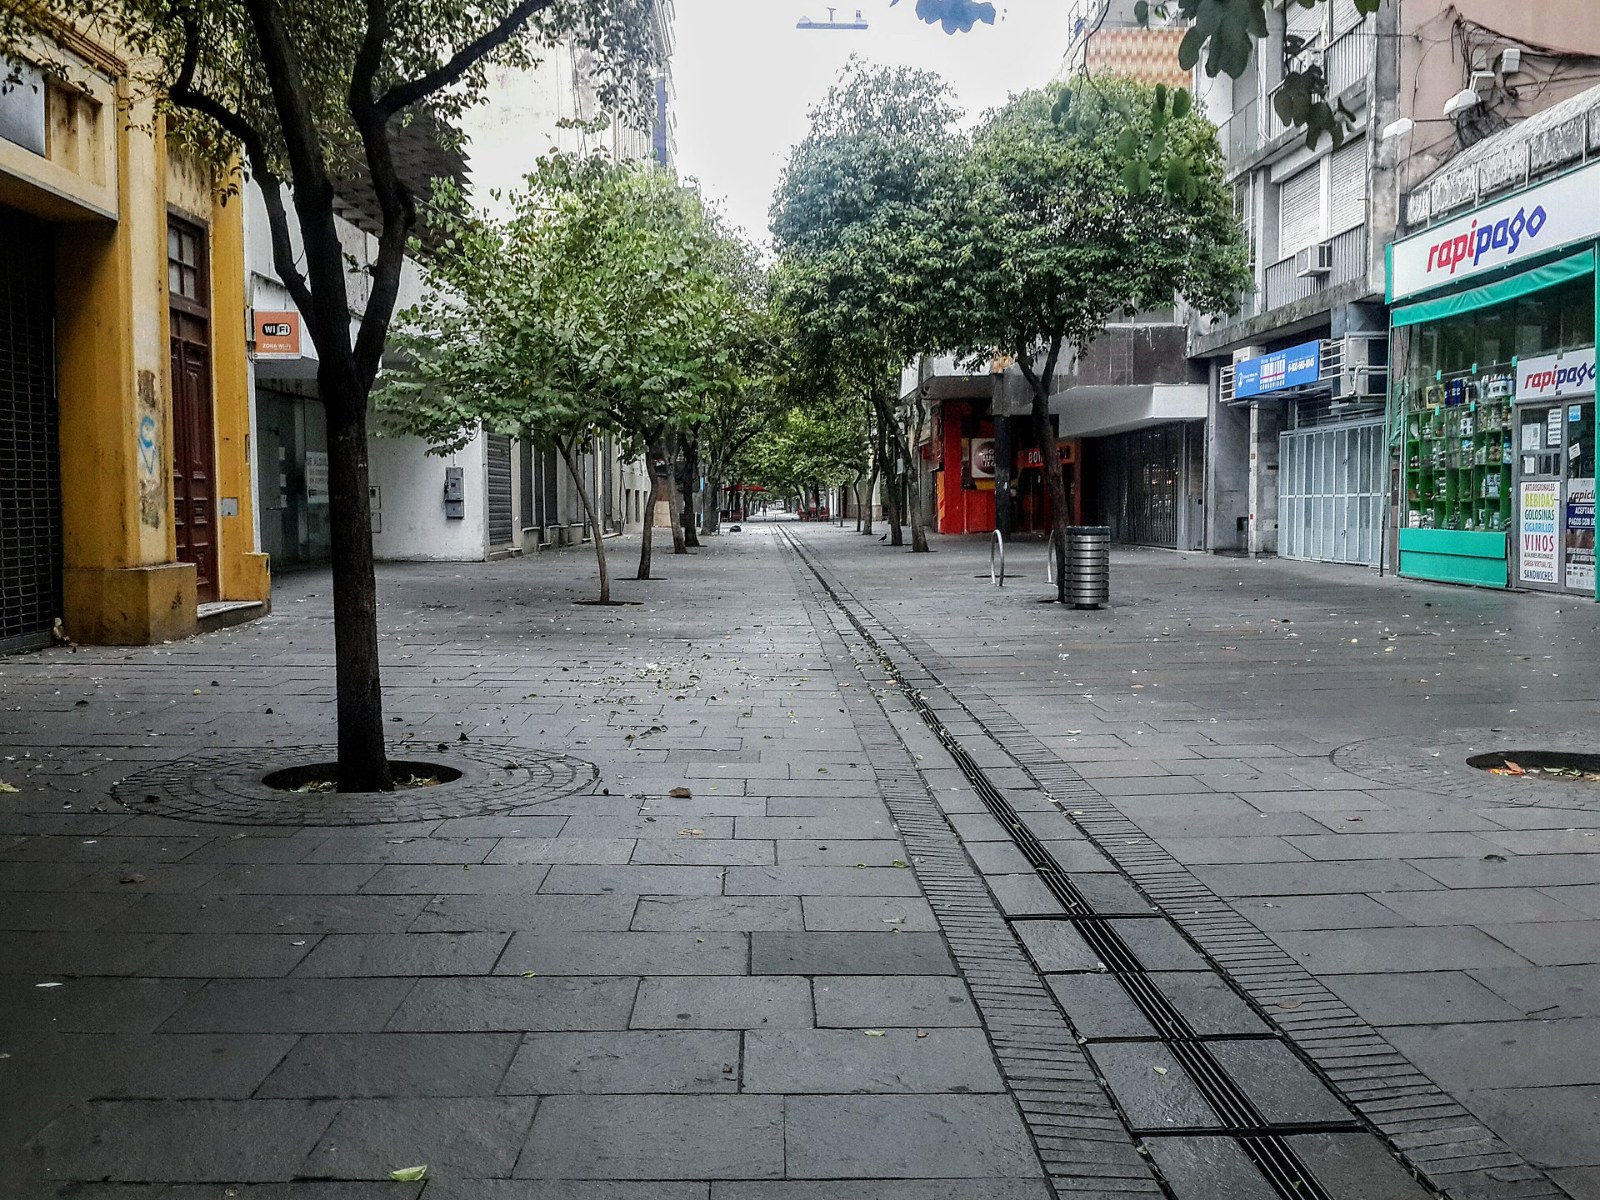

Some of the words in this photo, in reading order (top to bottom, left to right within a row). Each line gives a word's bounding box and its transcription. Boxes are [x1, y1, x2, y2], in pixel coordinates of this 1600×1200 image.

[1427, 205, 1547, 274] rapipago
[1525, 493, 1554, 507] BEBIDAS
[1525, 509, 1554, 520] GOLOSINAS
[1568, 517, 1581, 525] PAGOS
[1525, 522, 1554, 533] CIGARRILLOS
[1524, 534, 1554, 552] VINOS
[1524, 569, 1553, 581] SANDWICHES
